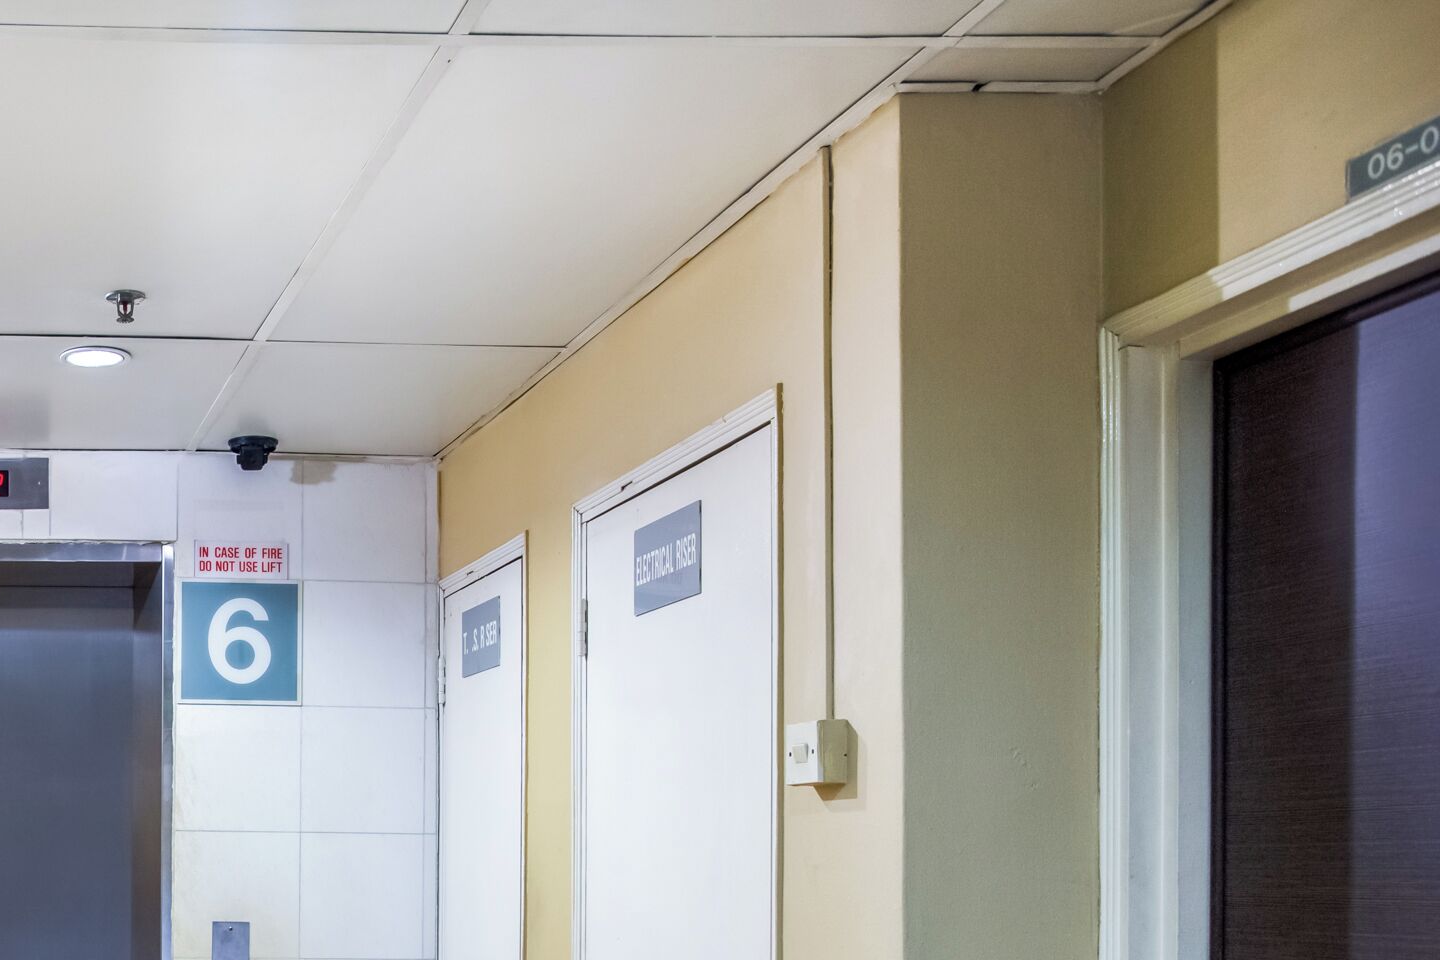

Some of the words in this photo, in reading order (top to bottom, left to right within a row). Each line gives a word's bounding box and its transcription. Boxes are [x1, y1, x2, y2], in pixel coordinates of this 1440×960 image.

[199, 546, 209, 558] IN
[214, 546, 240, 558] CASE
[244, 547, 257, 559] OF
[261, 548, 283, 559] FIRE
[199, 560, 212, 572] DO
[215, 560, 235, 572] NOT
[239, 561, 258, 572] USE
[261, 561, 283, 573] LIFT
[636, 543, 674, 587] ELECTRICAL
[676, 533, 697, 571] RISER
[207, 597, 272, 685] 6
